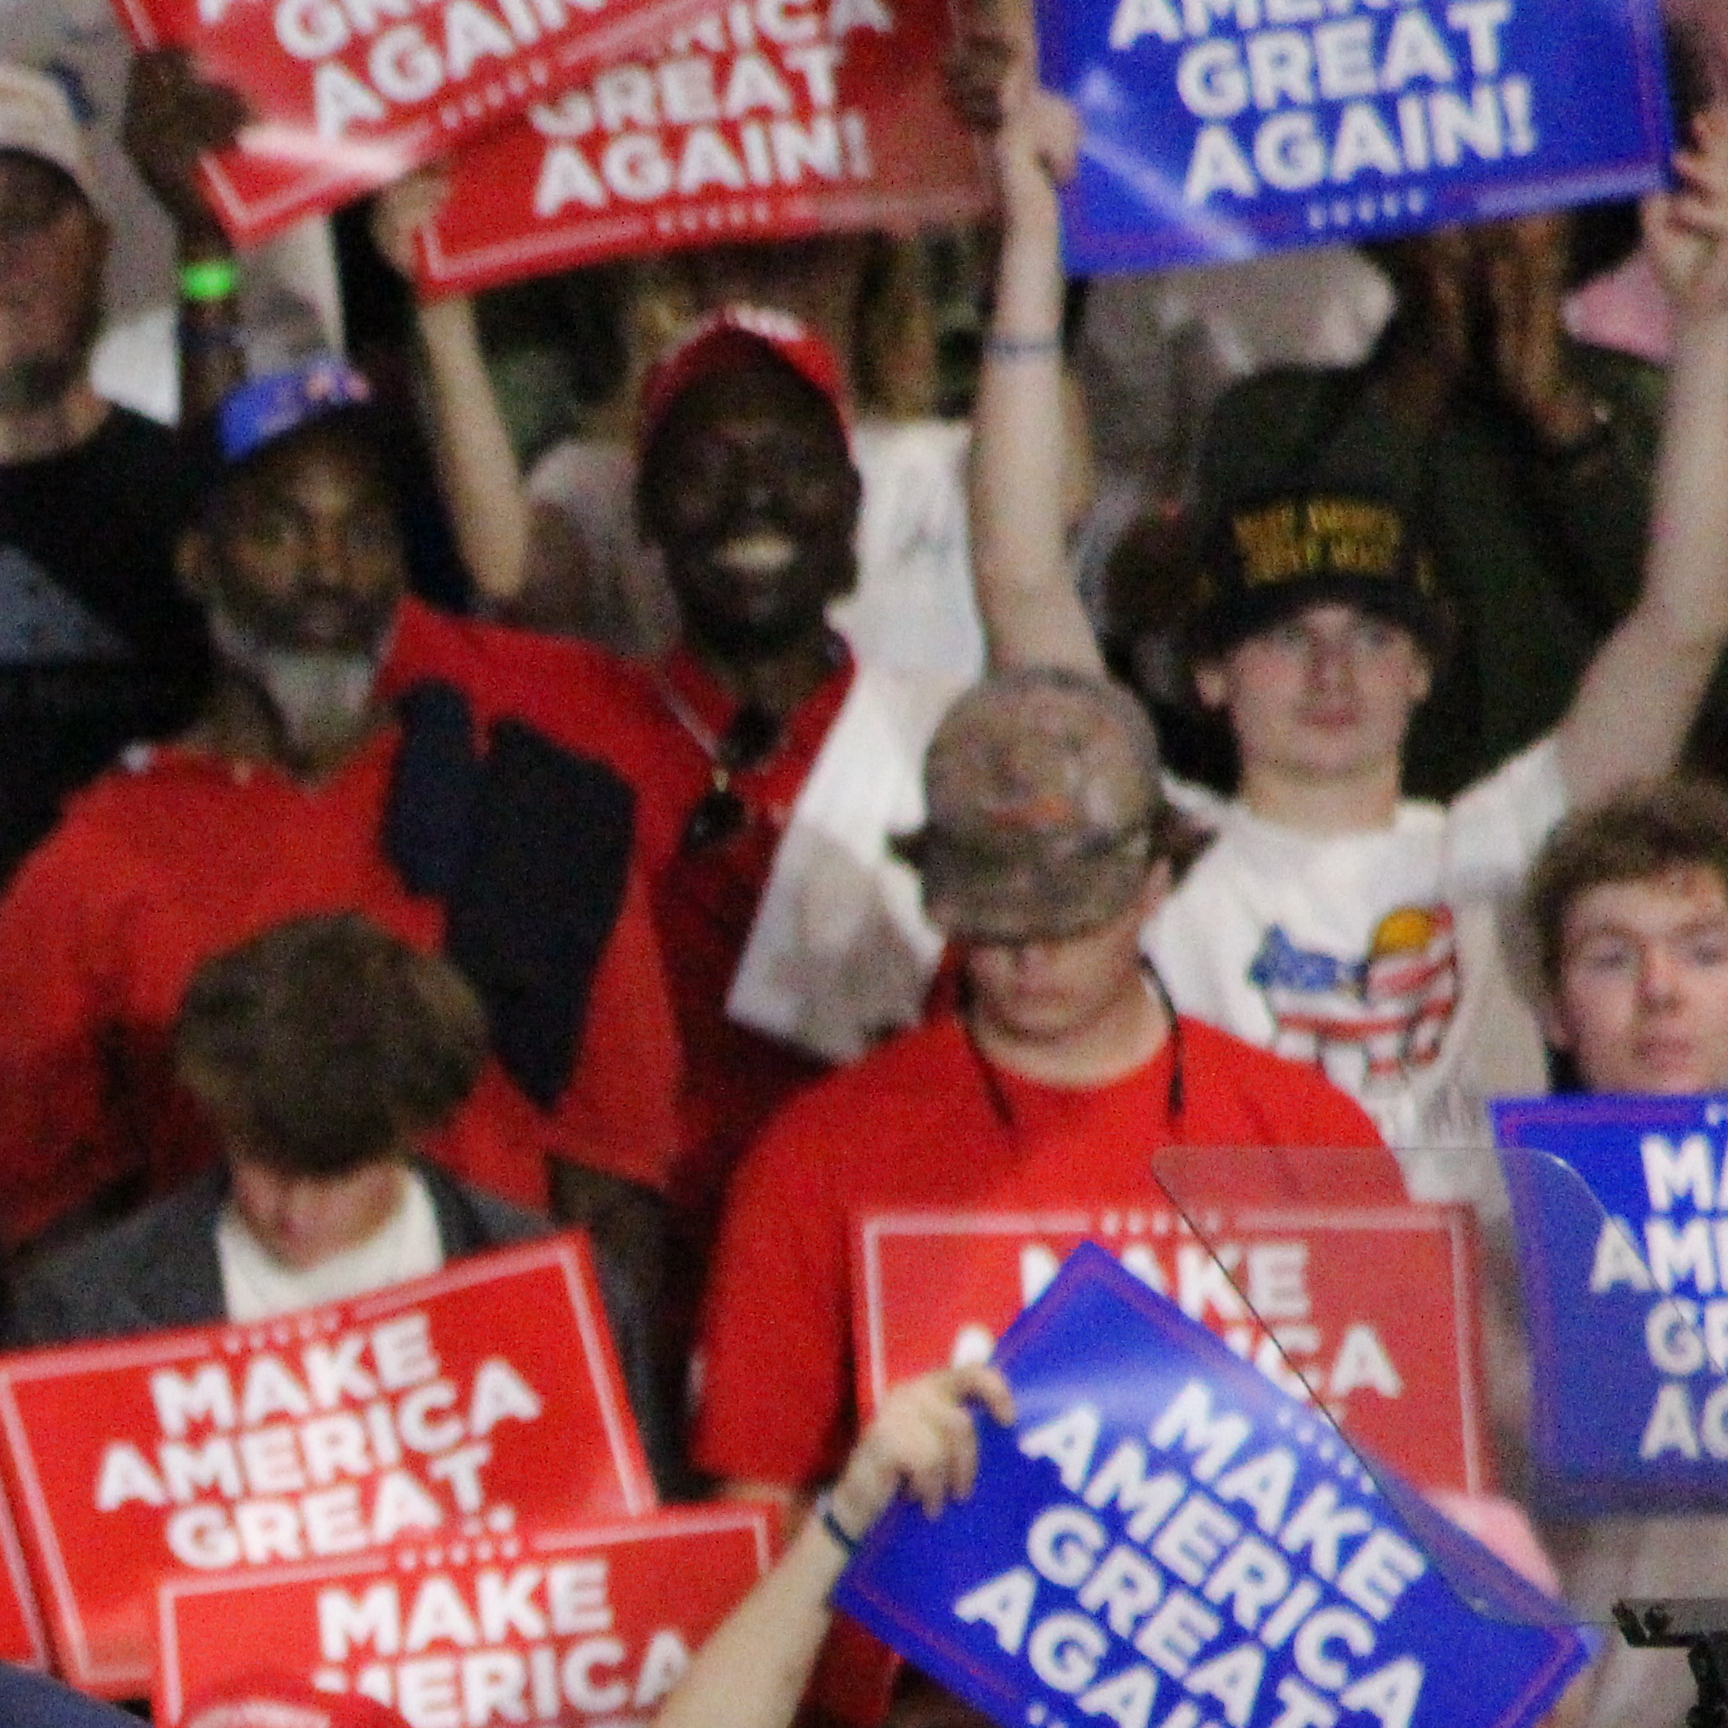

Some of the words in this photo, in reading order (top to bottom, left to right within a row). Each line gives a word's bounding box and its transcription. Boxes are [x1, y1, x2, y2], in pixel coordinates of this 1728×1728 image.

[313, 0, 606, 143] AGAI
[1176, 2, 1514, 120] GREAT
[533, 111, 871, 217] AGAIN!
[1184, 74, 1537, 202] AGAIN!
[94, 1358, 541, 1513] AMERICA
[149, 1311, 441, 1443] MAKE
[163, 1443, 493, 1569] GREAT
[1150, 1380, 1425, 1623] MAKE
[317, 1557, 615, 1664] MAKE
